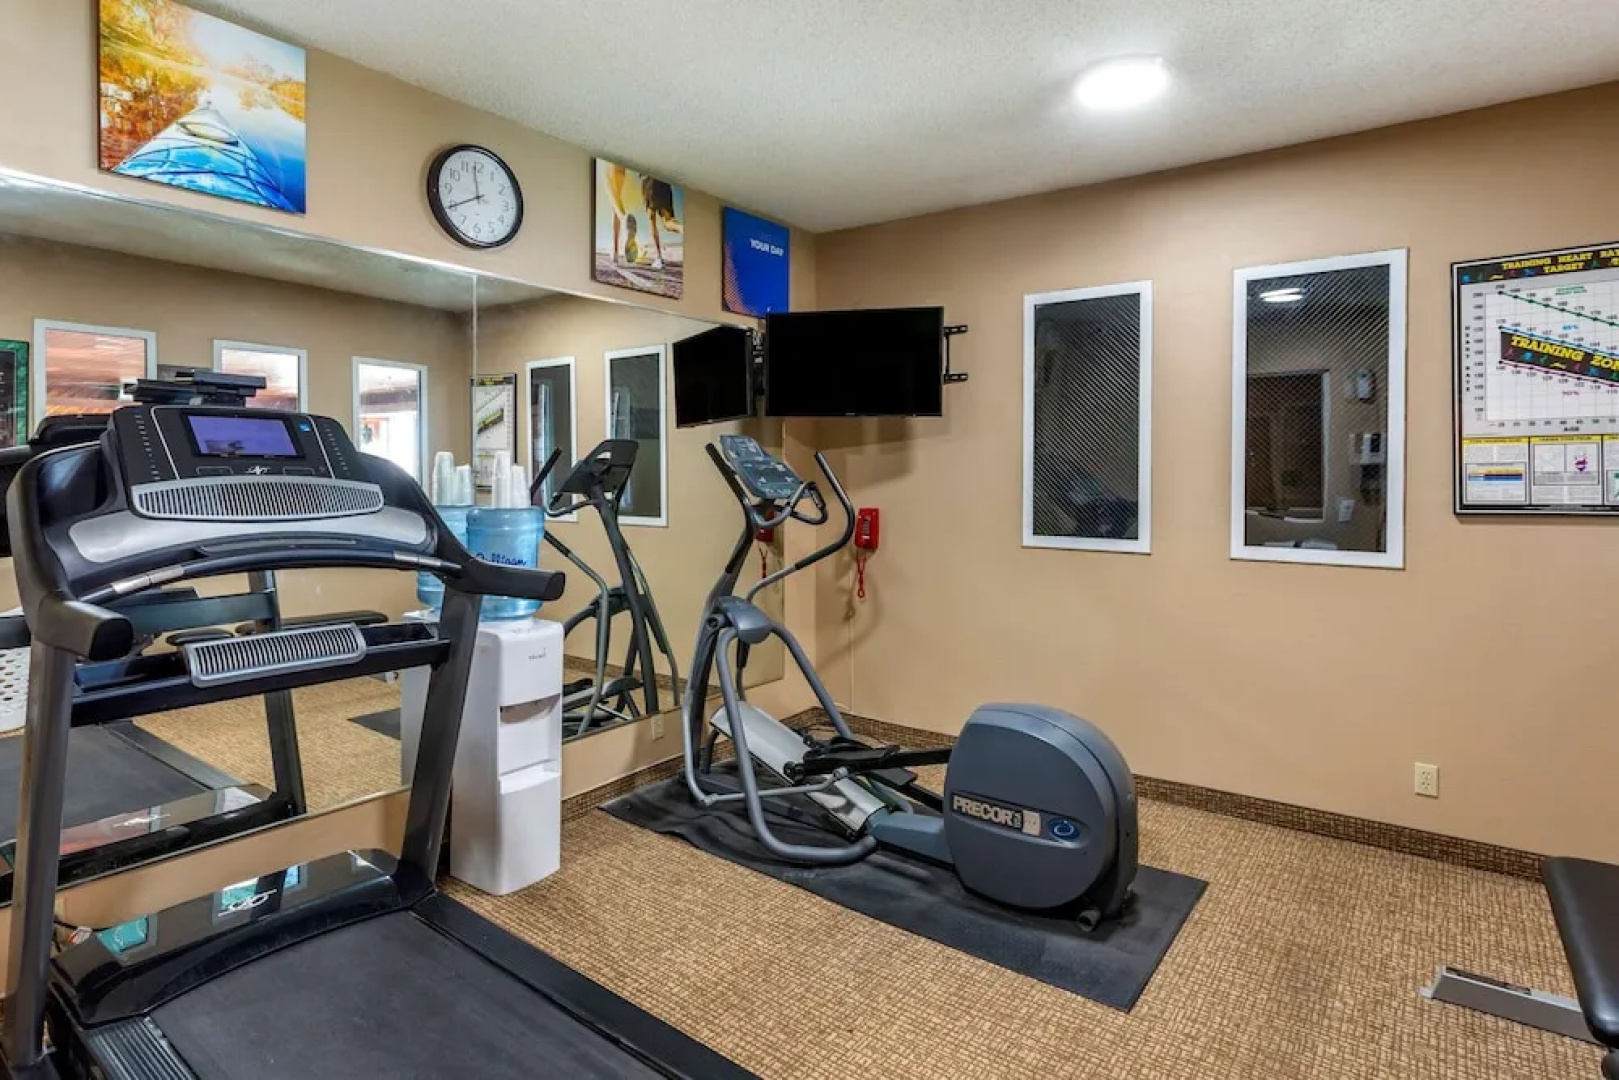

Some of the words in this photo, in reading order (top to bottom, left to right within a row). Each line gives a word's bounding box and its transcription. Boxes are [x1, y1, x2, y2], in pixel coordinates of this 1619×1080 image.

[461, 159, 469, 173] 11
[449, 167, 460, 182] 10
[444, 182, 454, 195] 9
[498, 183, 506, 196] 2
[502, 200, 509, 213] 3
[460, 214, 467, 226] 7
[497, 214, 504, 225] 4
[473, 222, 481, 234] 6
[488, 221, 495, 234] 5
[749, 237, 770, 253] YOUR
[1501, 257, 1552, 271] TRAINING
[1557, 251, 1594, 264] HEART
[1542, 261, 1587, 274] TARGET
[1510, 334, 1586, 362] TRAINING
[952, 794, 1012, 827] PRECOR
